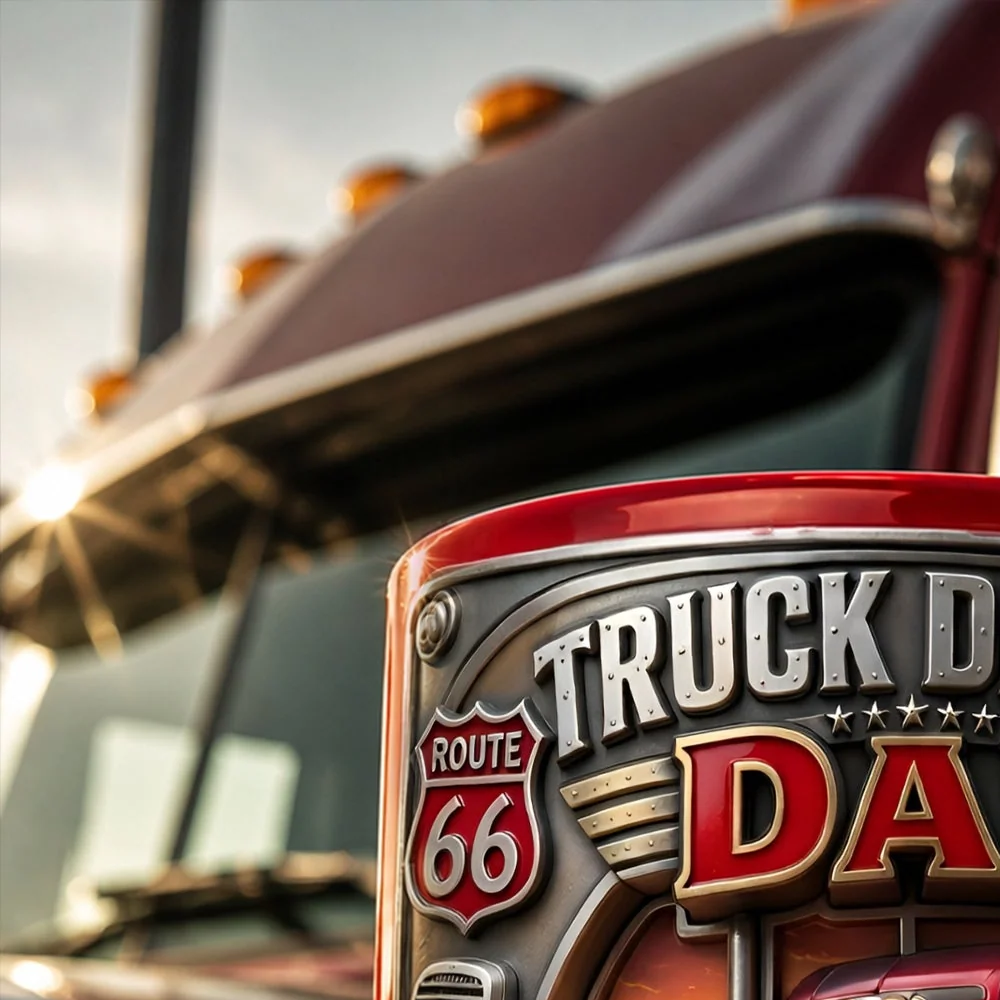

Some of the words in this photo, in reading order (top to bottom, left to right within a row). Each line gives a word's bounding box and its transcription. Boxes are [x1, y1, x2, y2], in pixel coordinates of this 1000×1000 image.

[534, 571, 895, 764] TRUCK
[431, 731, 522, 772] ROUTE
[424, 793, 519, 896] 66
